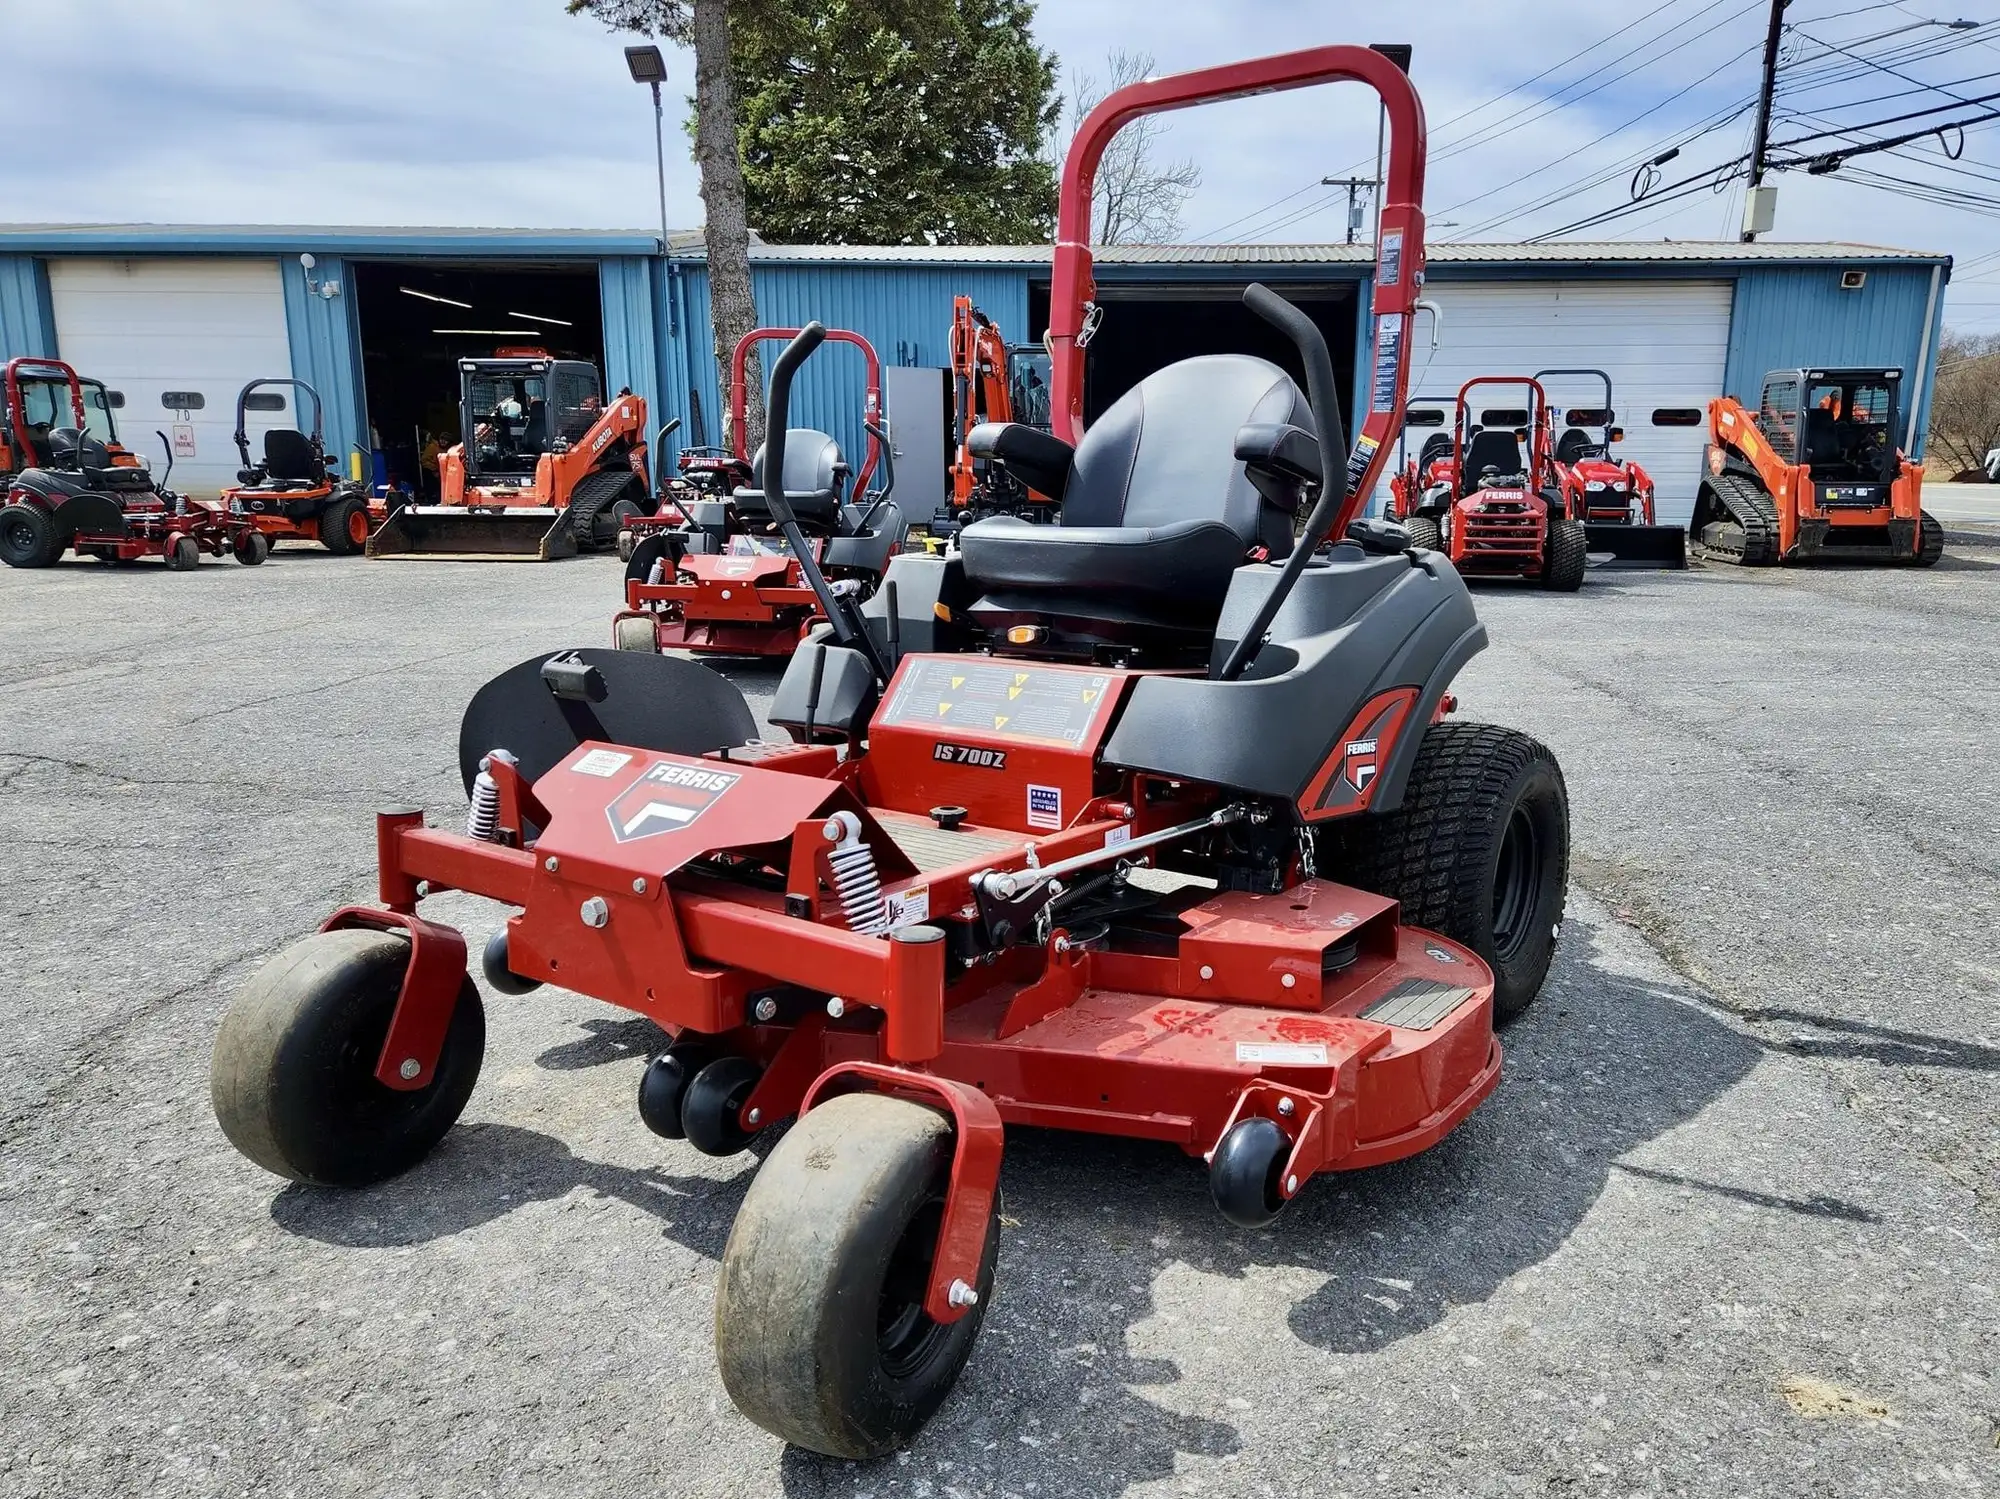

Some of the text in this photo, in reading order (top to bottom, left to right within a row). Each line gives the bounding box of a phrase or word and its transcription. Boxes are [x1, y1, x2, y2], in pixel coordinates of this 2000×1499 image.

[592, 426, 613, 454] KUBOTA
[1485, 491, 1524, 500] FERRIS
[934, 744, 1006, 768] IS 700Z
[1347, 741, 1376, 756] FERRIS
[647, 764, 730, 791] FERRIS
